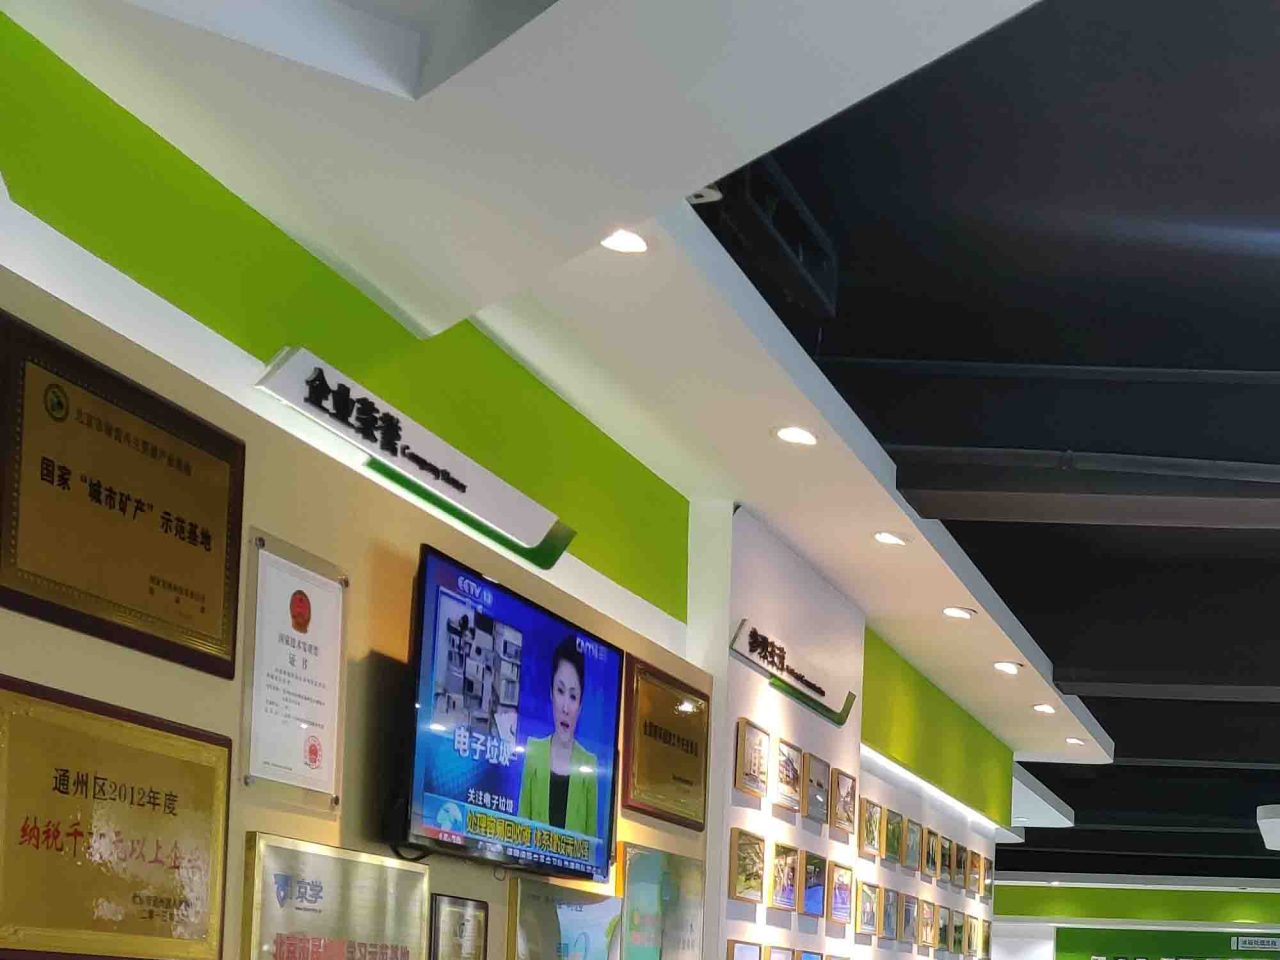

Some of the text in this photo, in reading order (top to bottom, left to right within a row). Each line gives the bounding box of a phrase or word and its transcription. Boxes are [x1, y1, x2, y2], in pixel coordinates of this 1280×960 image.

[52, 767, 179, 817] 通州区2012年度
